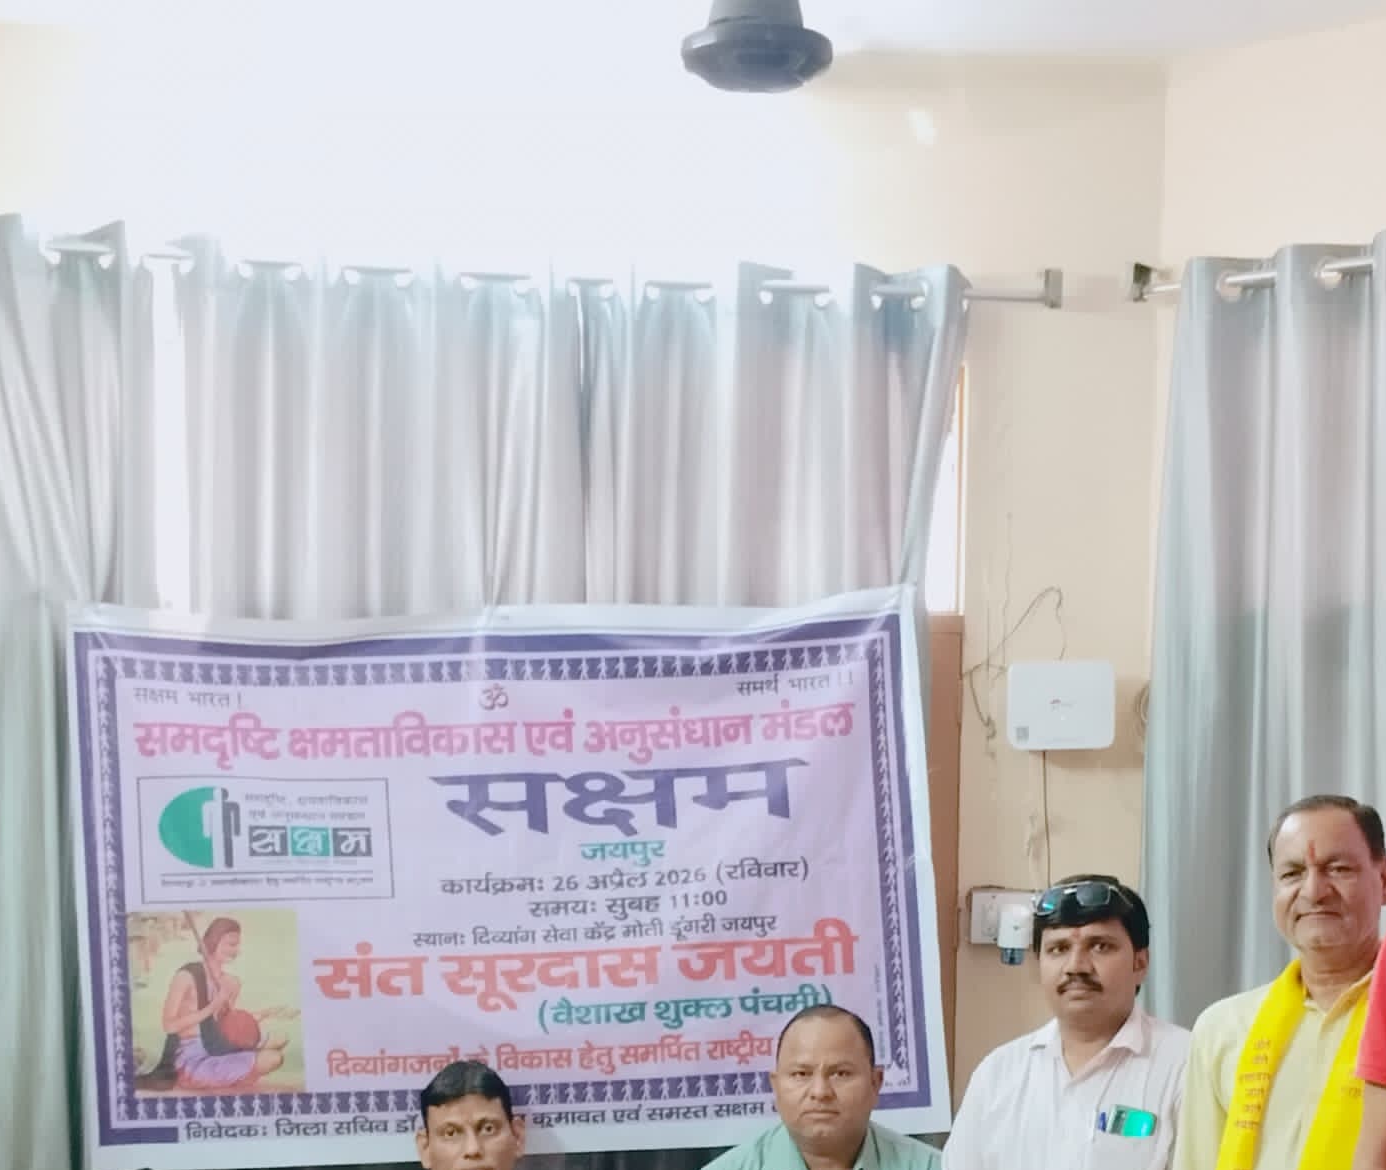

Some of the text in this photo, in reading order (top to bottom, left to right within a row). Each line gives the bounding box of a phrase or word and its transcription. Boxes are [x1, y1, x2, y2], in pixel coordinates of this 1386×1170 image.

[132, 687, 179, 704] सक्षम
[736, 674, 780, 697] समर्थ
[132, 698, 856, 770] समदृष्टि क्षमताविकास एवं अनुसंधान मंडल
[428, 757, 811, 837] सक्षम
[251, 828, 371, 856] सक्षम
[578, 839, 666, 866] जयपुर
[552, 875, 579, 892] 26
[655, 867, 707, 887] 2026
[715, 855, 810, 887] (रविवार)
[604, 895, 662, 921] सुबह
[669, 889, 728, 909] 11:00
[472, 925, 537, 946] दिव्यांग
[542, 924, 578, 944] सेवा
[621, 917, 664, 938] मोती
[721, 914, 778, 938] जयपुर
[312, 941, 429, 1000] संत
[437, 944, 662, 1013] सूरदास
[537, 982, 833, 1035] (वैशाख शुक्ल पंचमी)
[495, 1043, 573, 1072] विकास
[578, 1039, 617, 1076] हेतु
[619, 1032, 702, 1067] समर्पित
[706, 1028, 774, 1067] राष्ट्रीय
[274, 1117, 328, 1137] जिला
[332, 1115, 390, 1136] सचिव
[612, 1103, 644, 1123] एवं
[646, 1104, 708, 1122] समस्त
[714, 1101, 766, 1119] सक्षम
